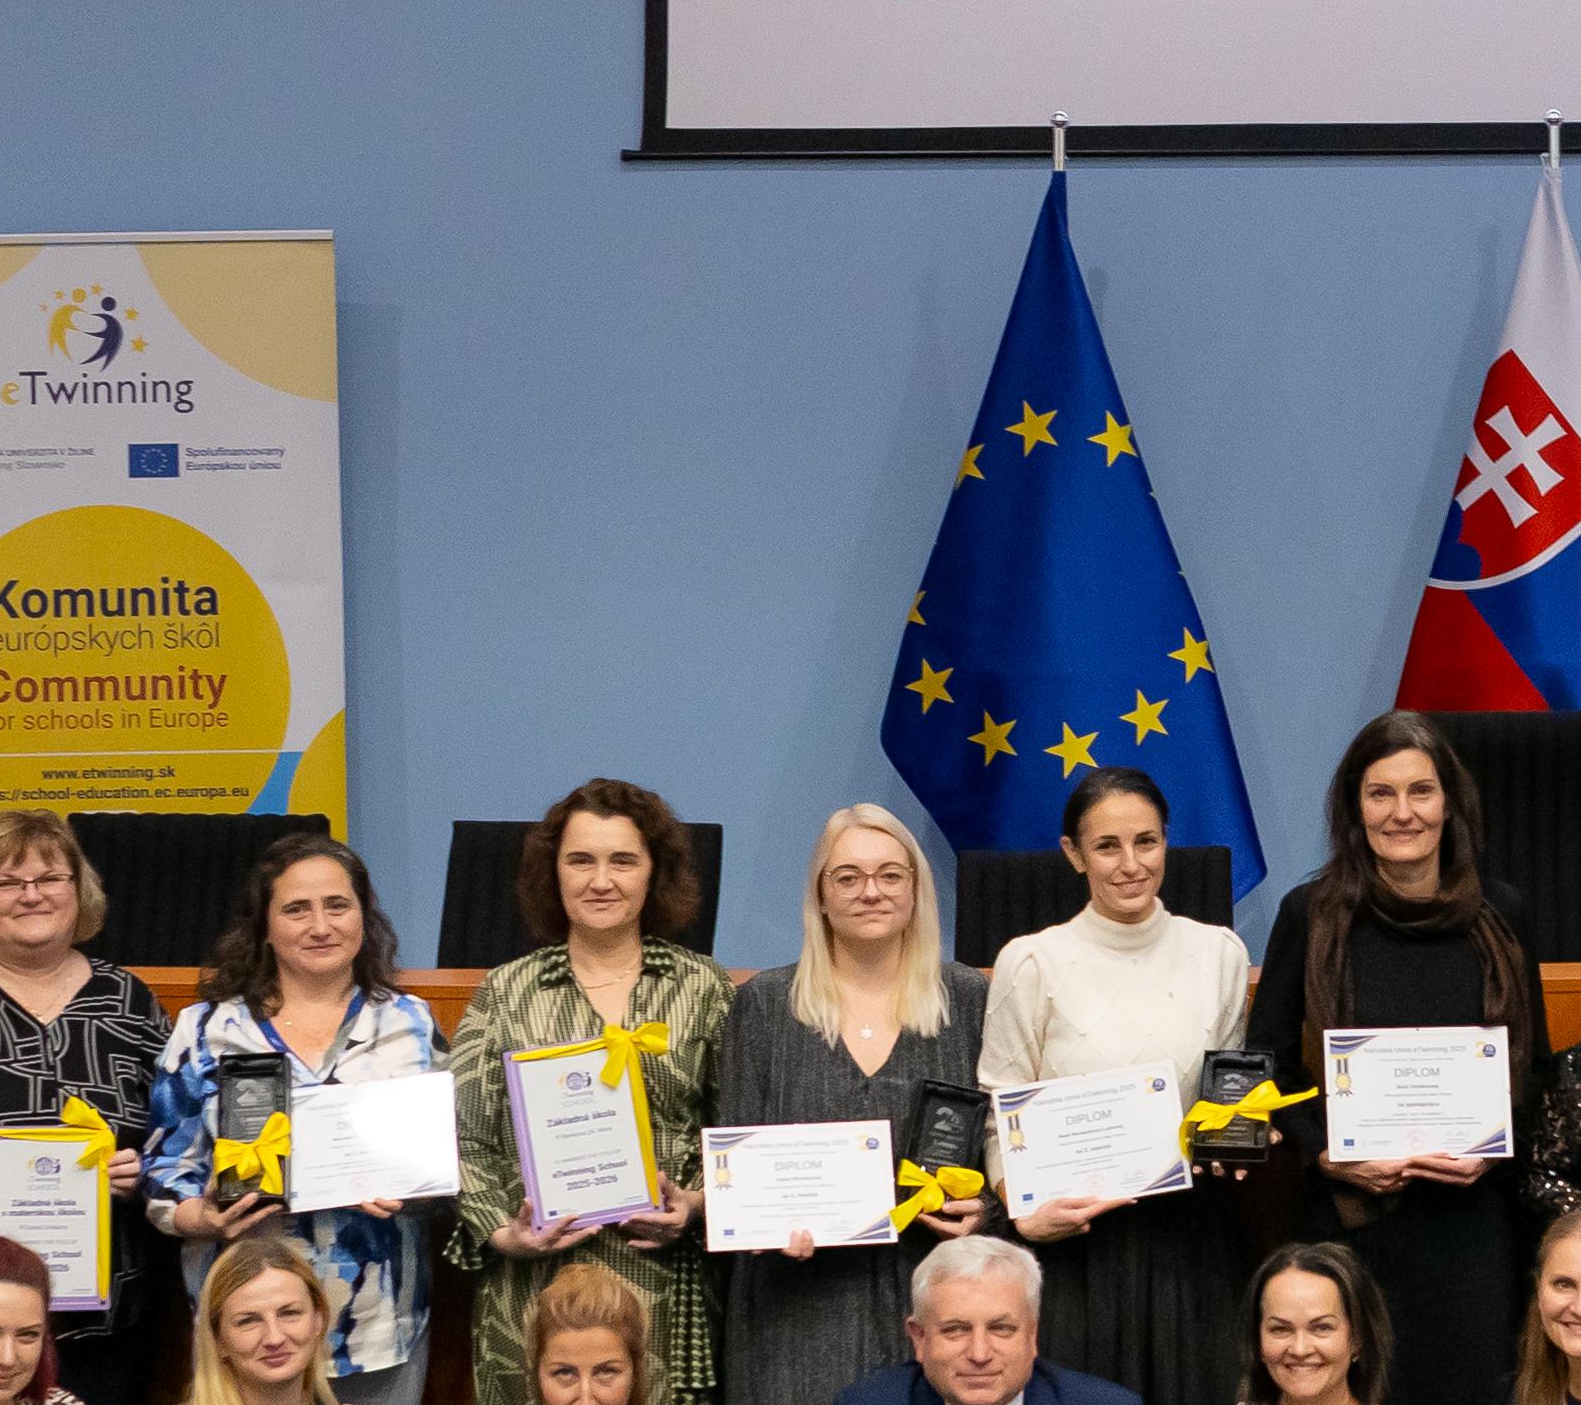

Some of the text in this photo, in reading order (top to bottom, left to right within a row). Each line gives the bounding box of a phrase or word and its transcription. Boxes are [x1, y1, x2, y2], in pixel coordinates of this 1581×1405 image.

[0, 372, 195, 413] eTwinning
[163, 621, 221, 651] škôl
[22, 707, 114, 730] schools
[121, 706, 142, 729] in
[150, 706, 229, 733] Europe
[41, 765, 176, 783] www.etwinning.sk
[1393, 1066, 1440, 1078] DIPLOM
[1064, 1109, 1113, 1126] DIPLOM
